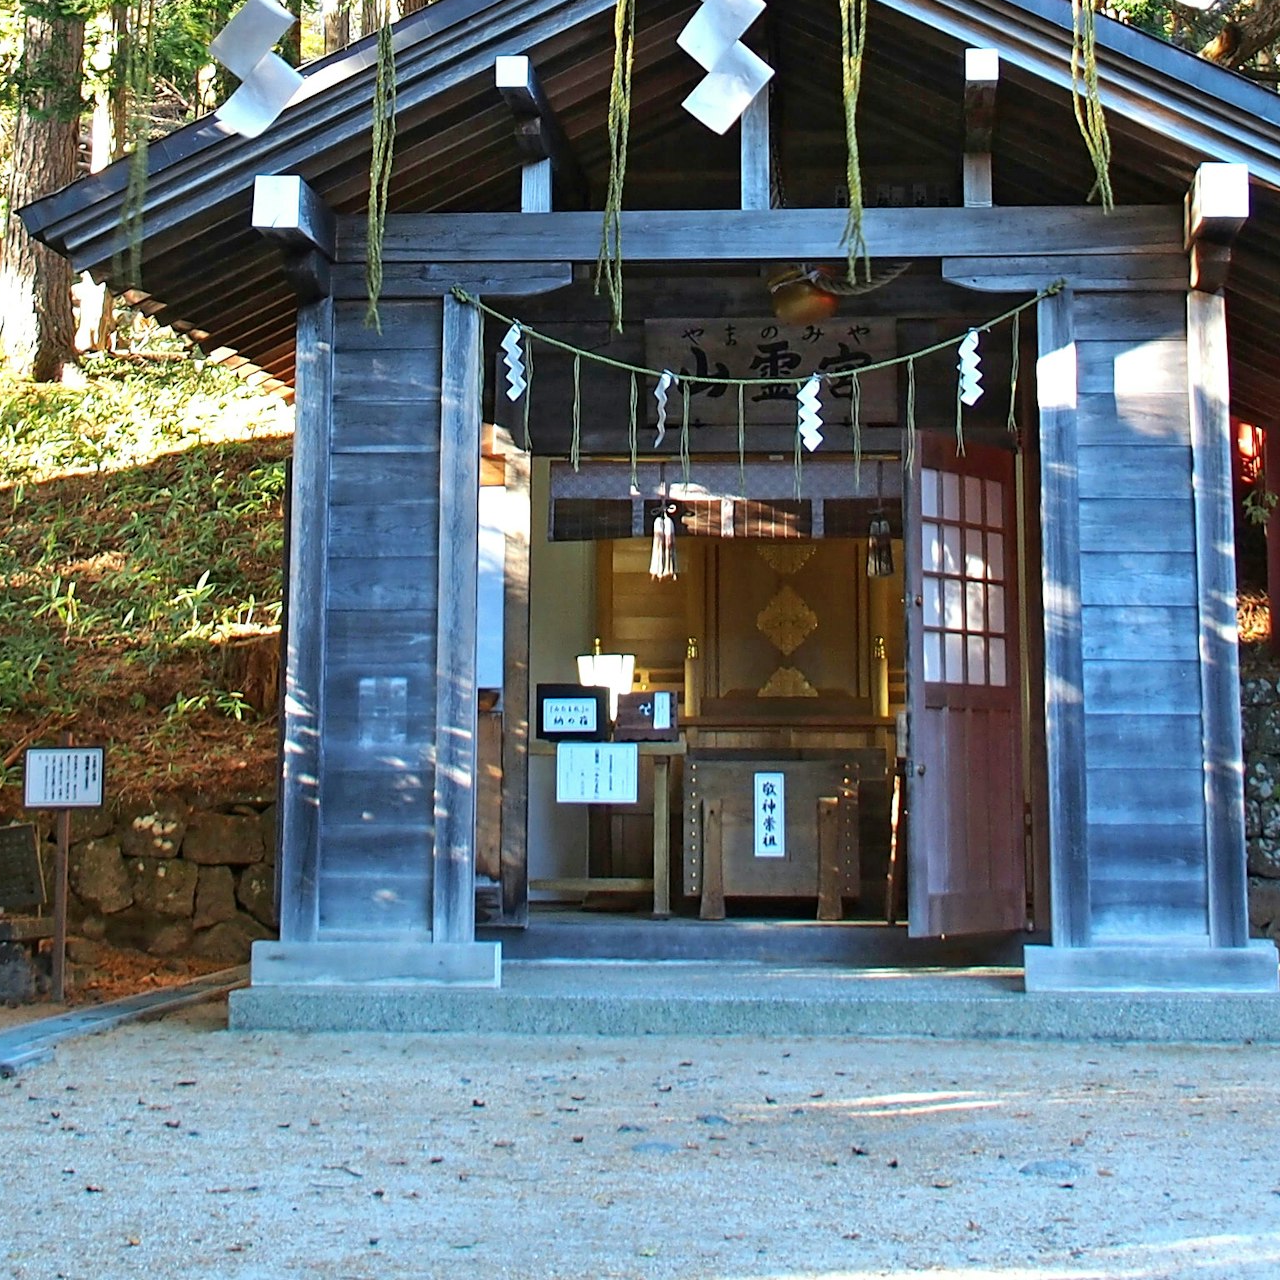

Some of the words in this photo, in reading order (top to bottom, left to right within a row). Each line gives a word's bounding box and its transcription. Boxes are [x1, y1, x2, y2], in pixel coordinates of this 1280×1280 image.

[681, 325, 871, 346] やまのみや
[677, 340, 873, 402] 山霊宮
